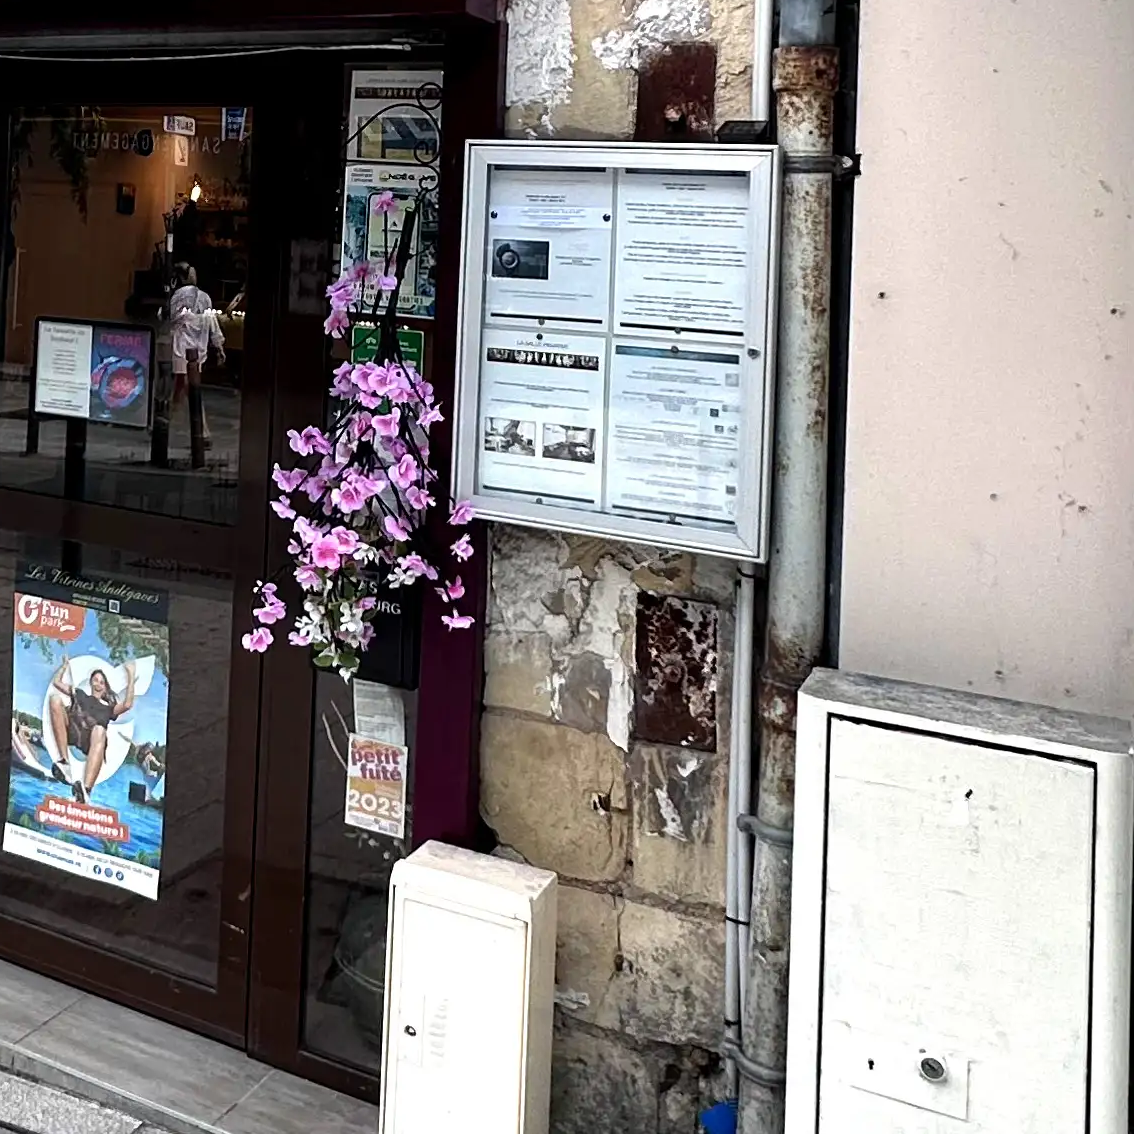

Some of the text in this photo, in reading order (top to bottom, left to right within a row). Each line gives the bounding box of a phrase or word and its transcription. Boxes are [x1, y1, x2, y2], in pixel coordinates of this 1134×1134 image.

[24, 564, 47, 581] Les
[41, 600, 69, 619] Fun
[40, 617, 63, 629] park
[351, 747, 402, 766] petit
[360, 763, 402, 782] futé
[348, 788, 403, 819] 2023
